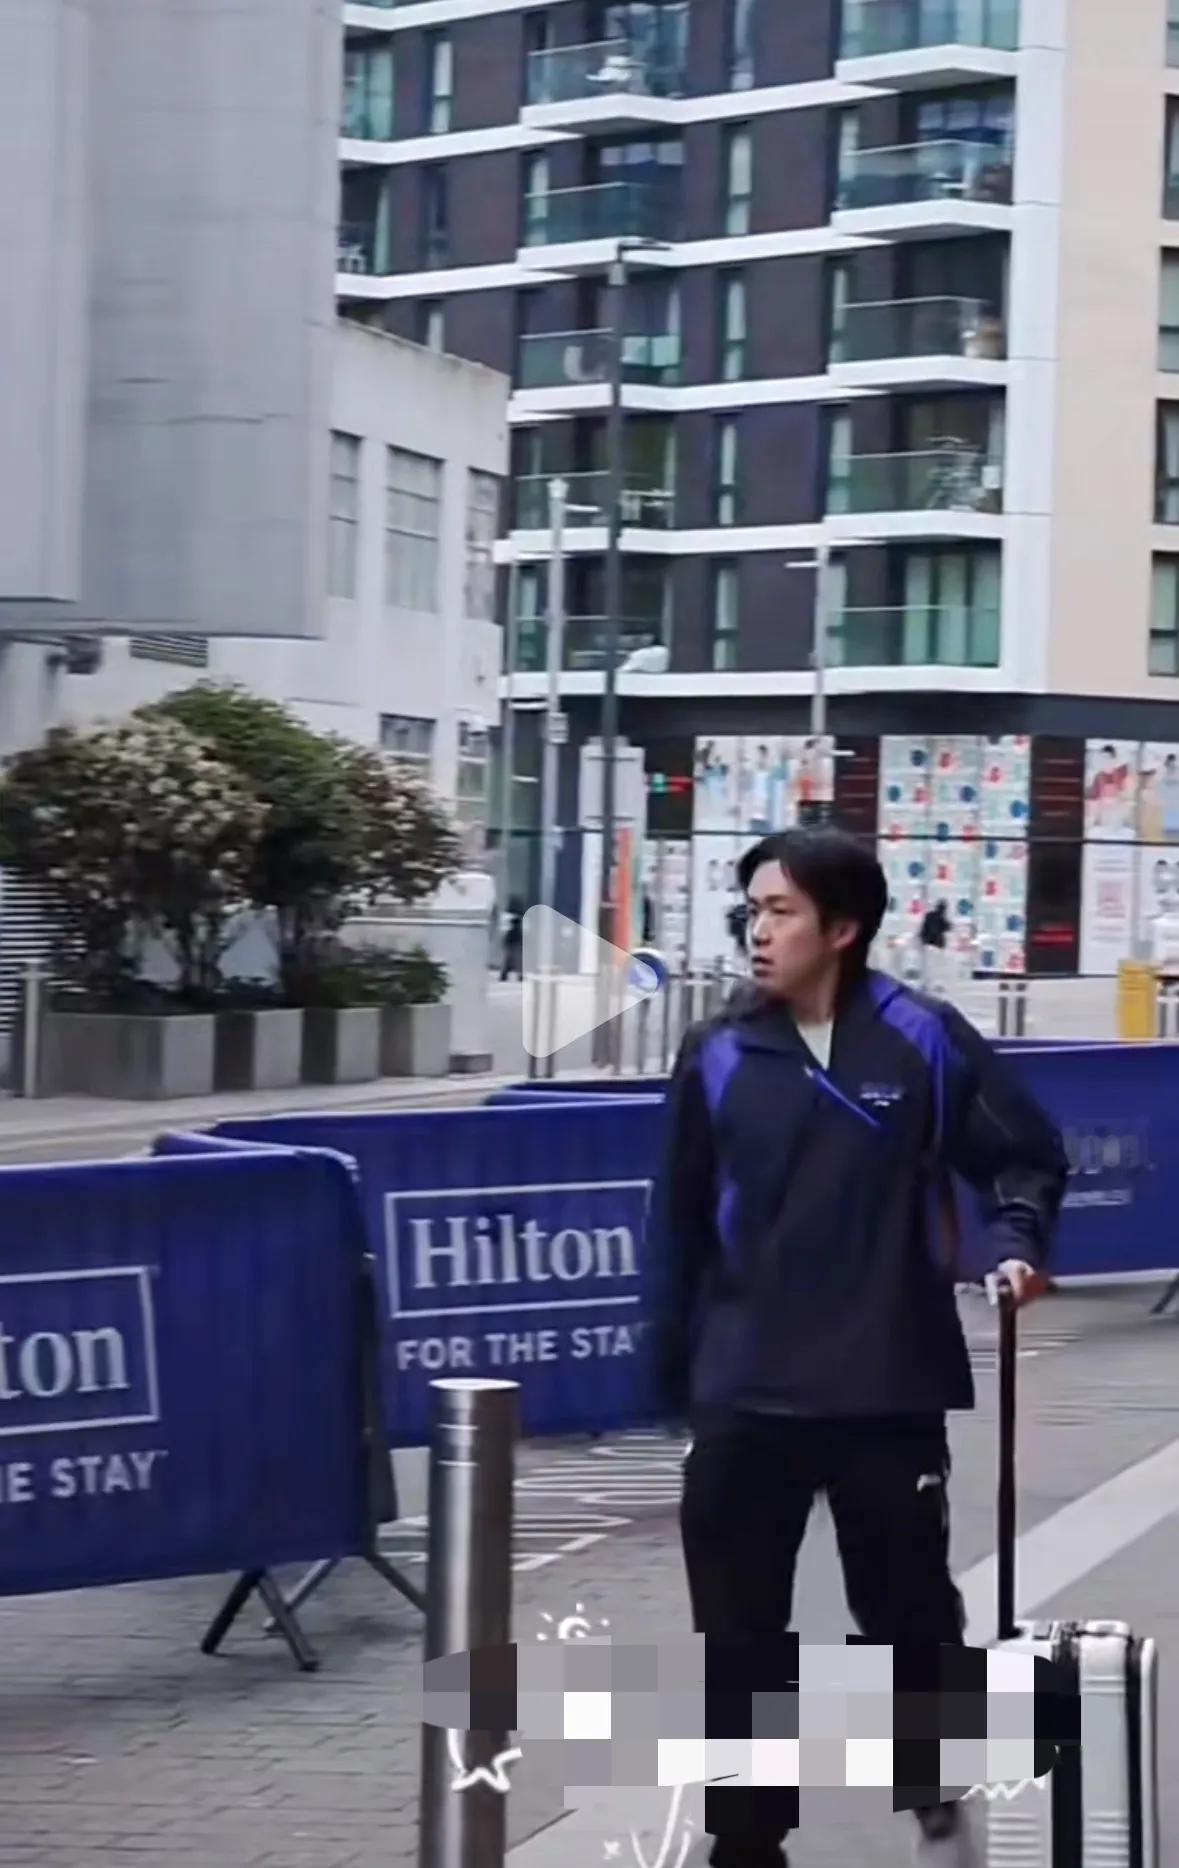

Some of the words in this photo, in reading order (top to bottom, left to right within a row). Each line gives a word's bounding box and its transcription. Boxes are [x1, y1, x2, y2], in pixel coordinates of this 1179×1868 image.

[409, 1214, 639, 1289] Hilton
[397, 1337, 474, 1370] FOR
[484, 1330, 559, 1364] THE
[0, 1461, 35, 1504] E
[51, 1451, 157, 1498] STAY
